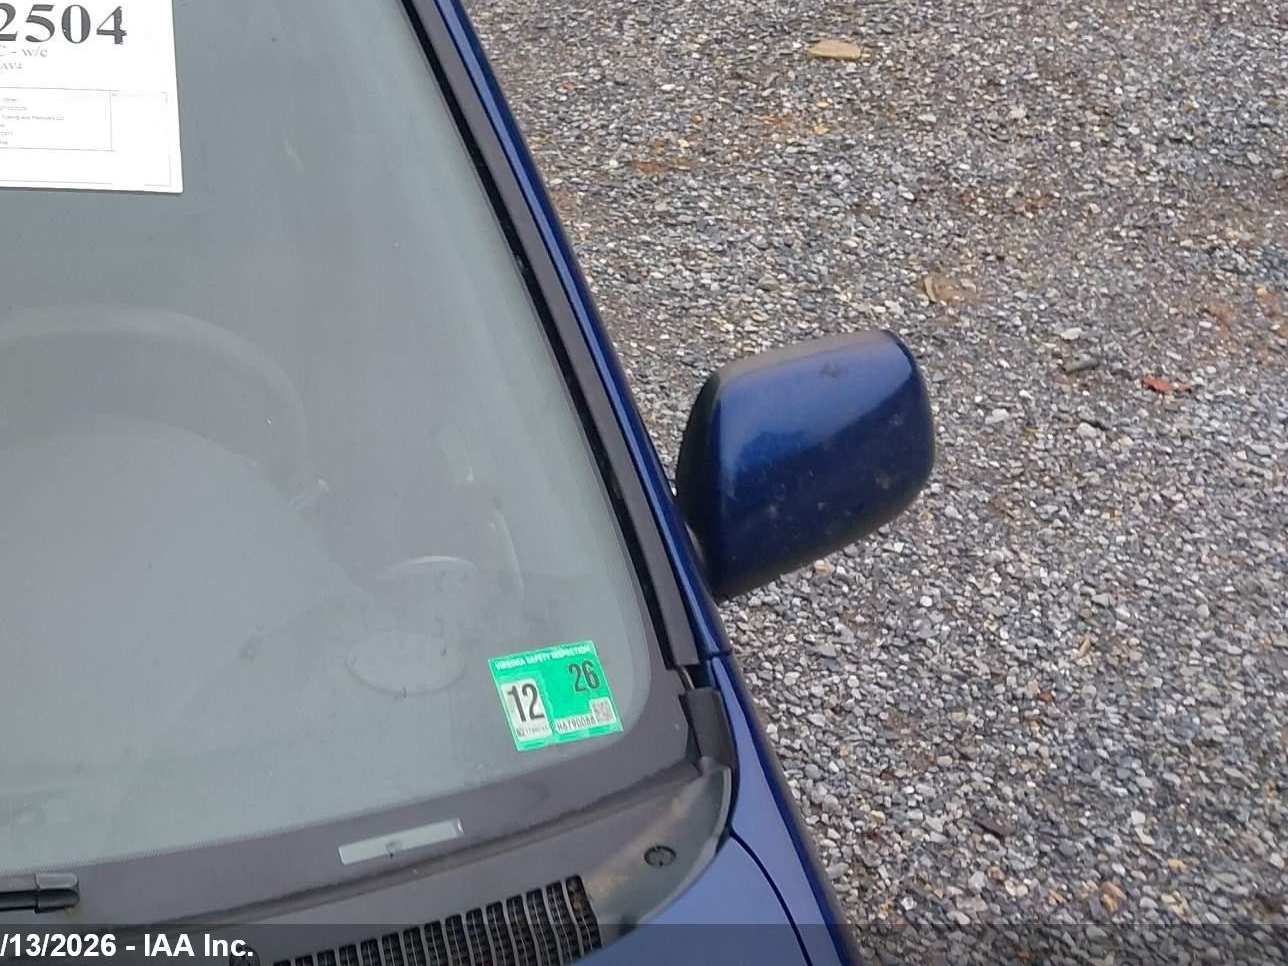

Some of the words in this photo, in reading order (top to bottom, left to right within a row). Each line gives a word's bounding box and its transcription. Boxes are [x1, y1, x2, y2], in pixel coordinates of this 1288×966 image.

[21, 45, 48, 58] w/c
[496, 659, 526, 669] VIRGINIA
[526, 653, 551, 665] SAFETY
[551, 645, 590, 659] INSPECTION
[568, 660, 601, 693] 26
[507, 683, 545, 723] 12
